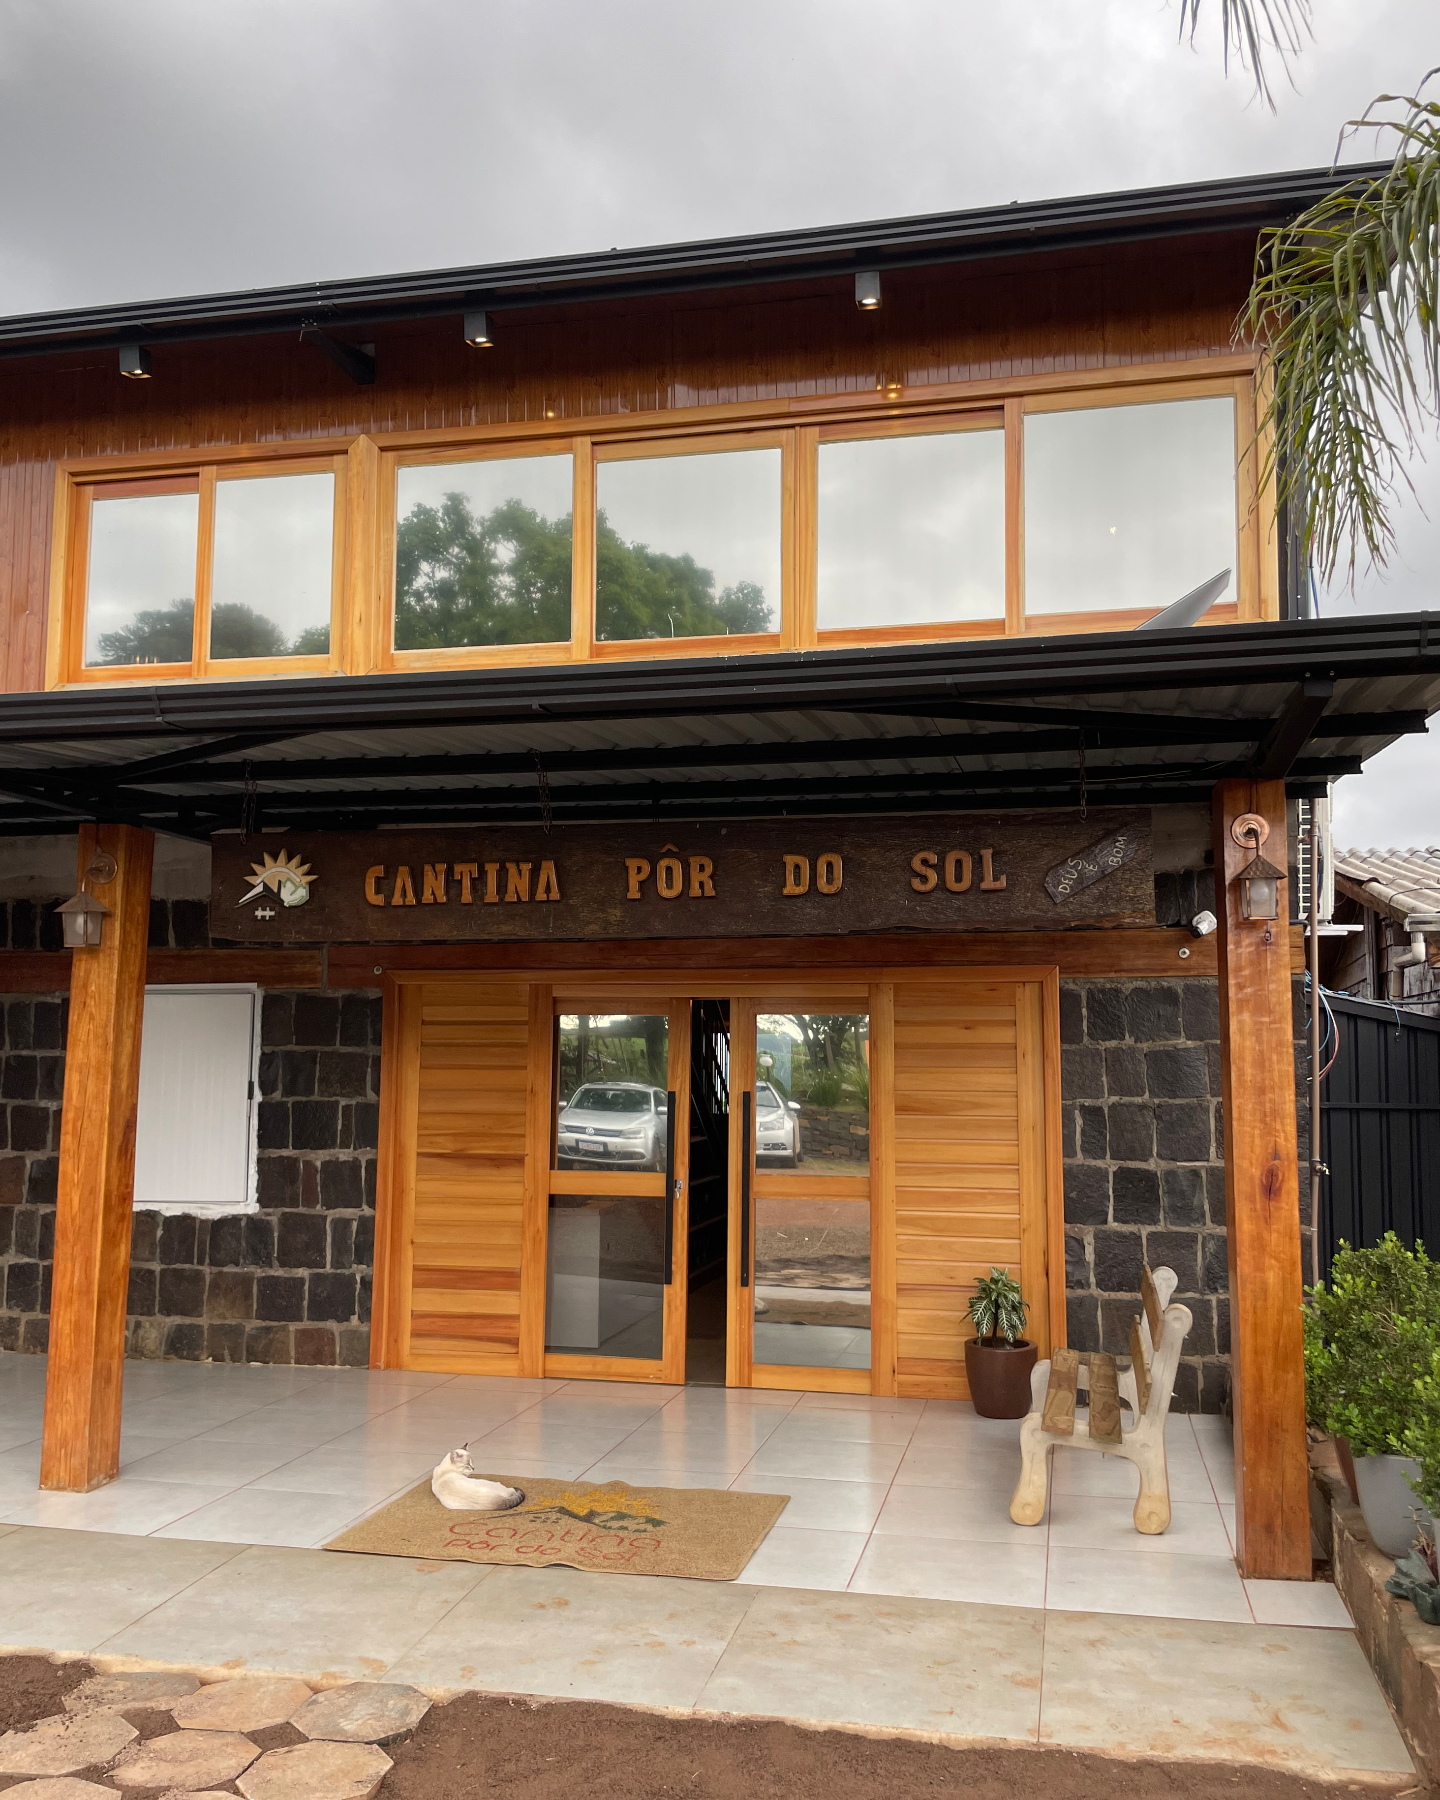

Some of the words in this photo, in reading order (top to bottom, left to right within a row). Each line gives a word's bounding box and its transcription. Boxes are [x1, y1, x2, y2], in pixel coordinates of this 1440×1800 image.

[1108, 836, 1127, 866] BOM
[365, 860, 561, 906] CANTINA
[625, 843, 717, 899] PÔR
[782, 852, 843, 896] DO
[911, 848, 1007, 893] SOL
[1058, 857, 1083, 893] DEUS
[449, 1522, 662, 1551] Cantina
[515, 1545, 562, 1556] do
